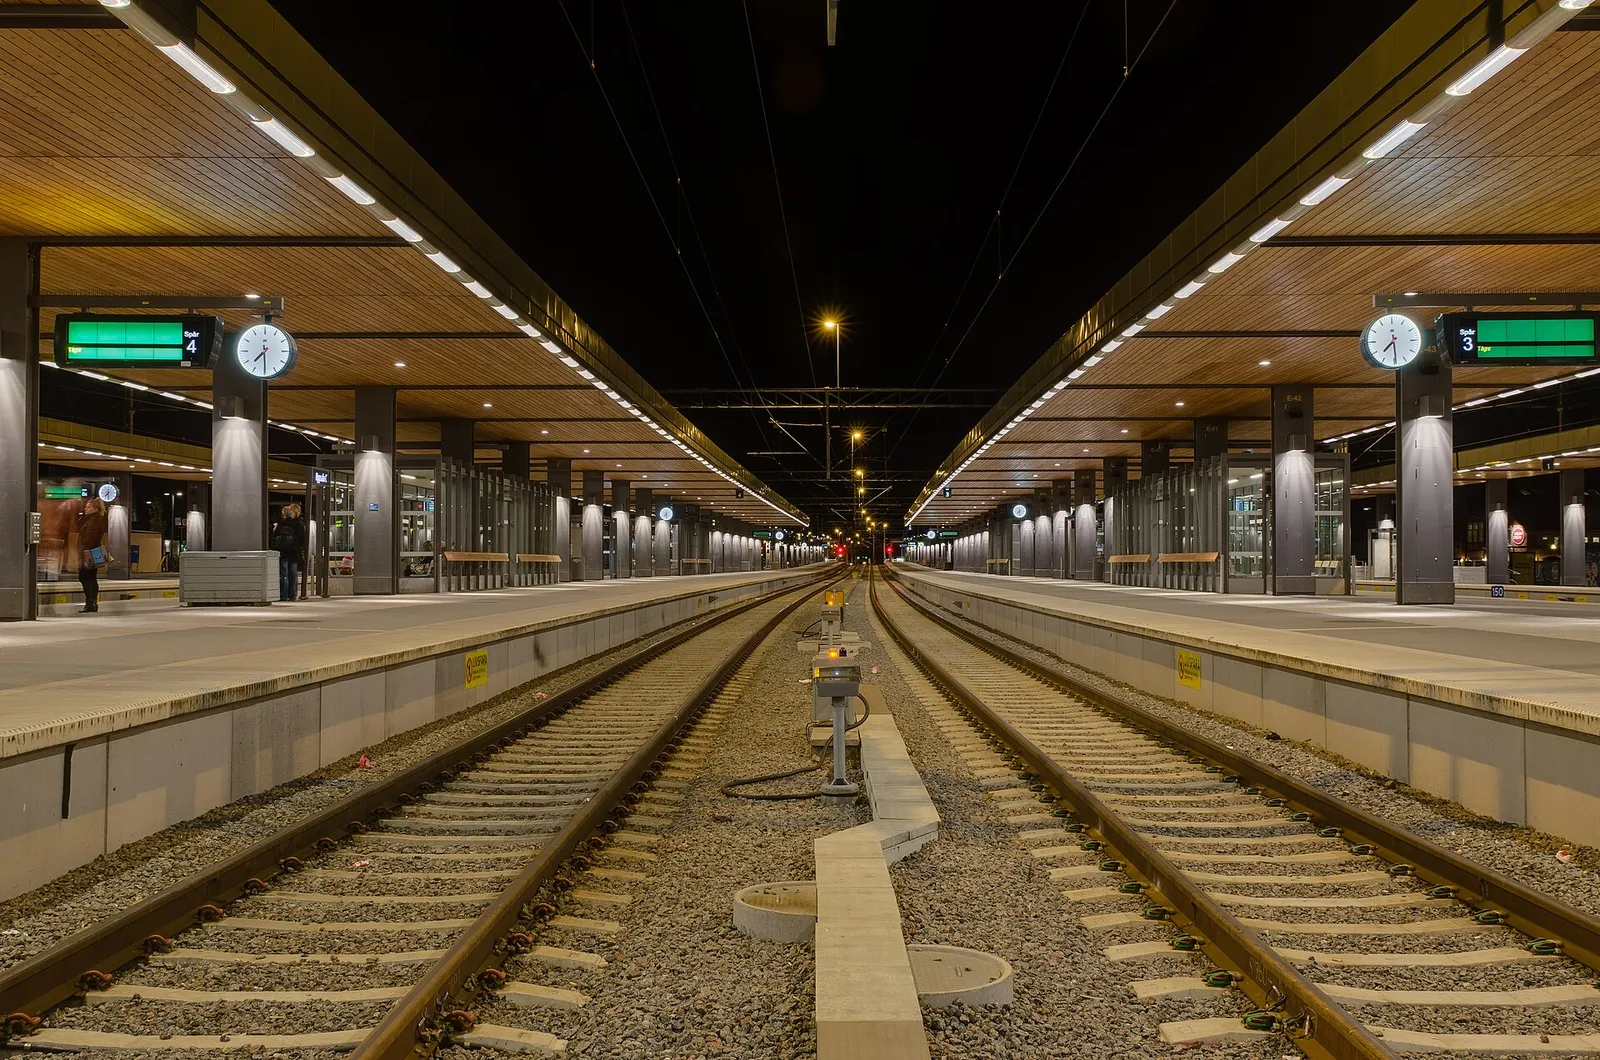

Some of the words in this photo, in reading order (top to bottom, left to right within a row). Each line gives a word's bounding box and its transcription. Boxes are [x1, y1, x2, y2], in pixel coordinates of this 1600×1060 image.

[183, 330, 200, 338] Spår
[1459, 328, 1476, 337] Spår
[186, 339, 197, 354] 4
[1462, 337, 1474, 351] 3
[1491, 587, 1504, 597] 150
